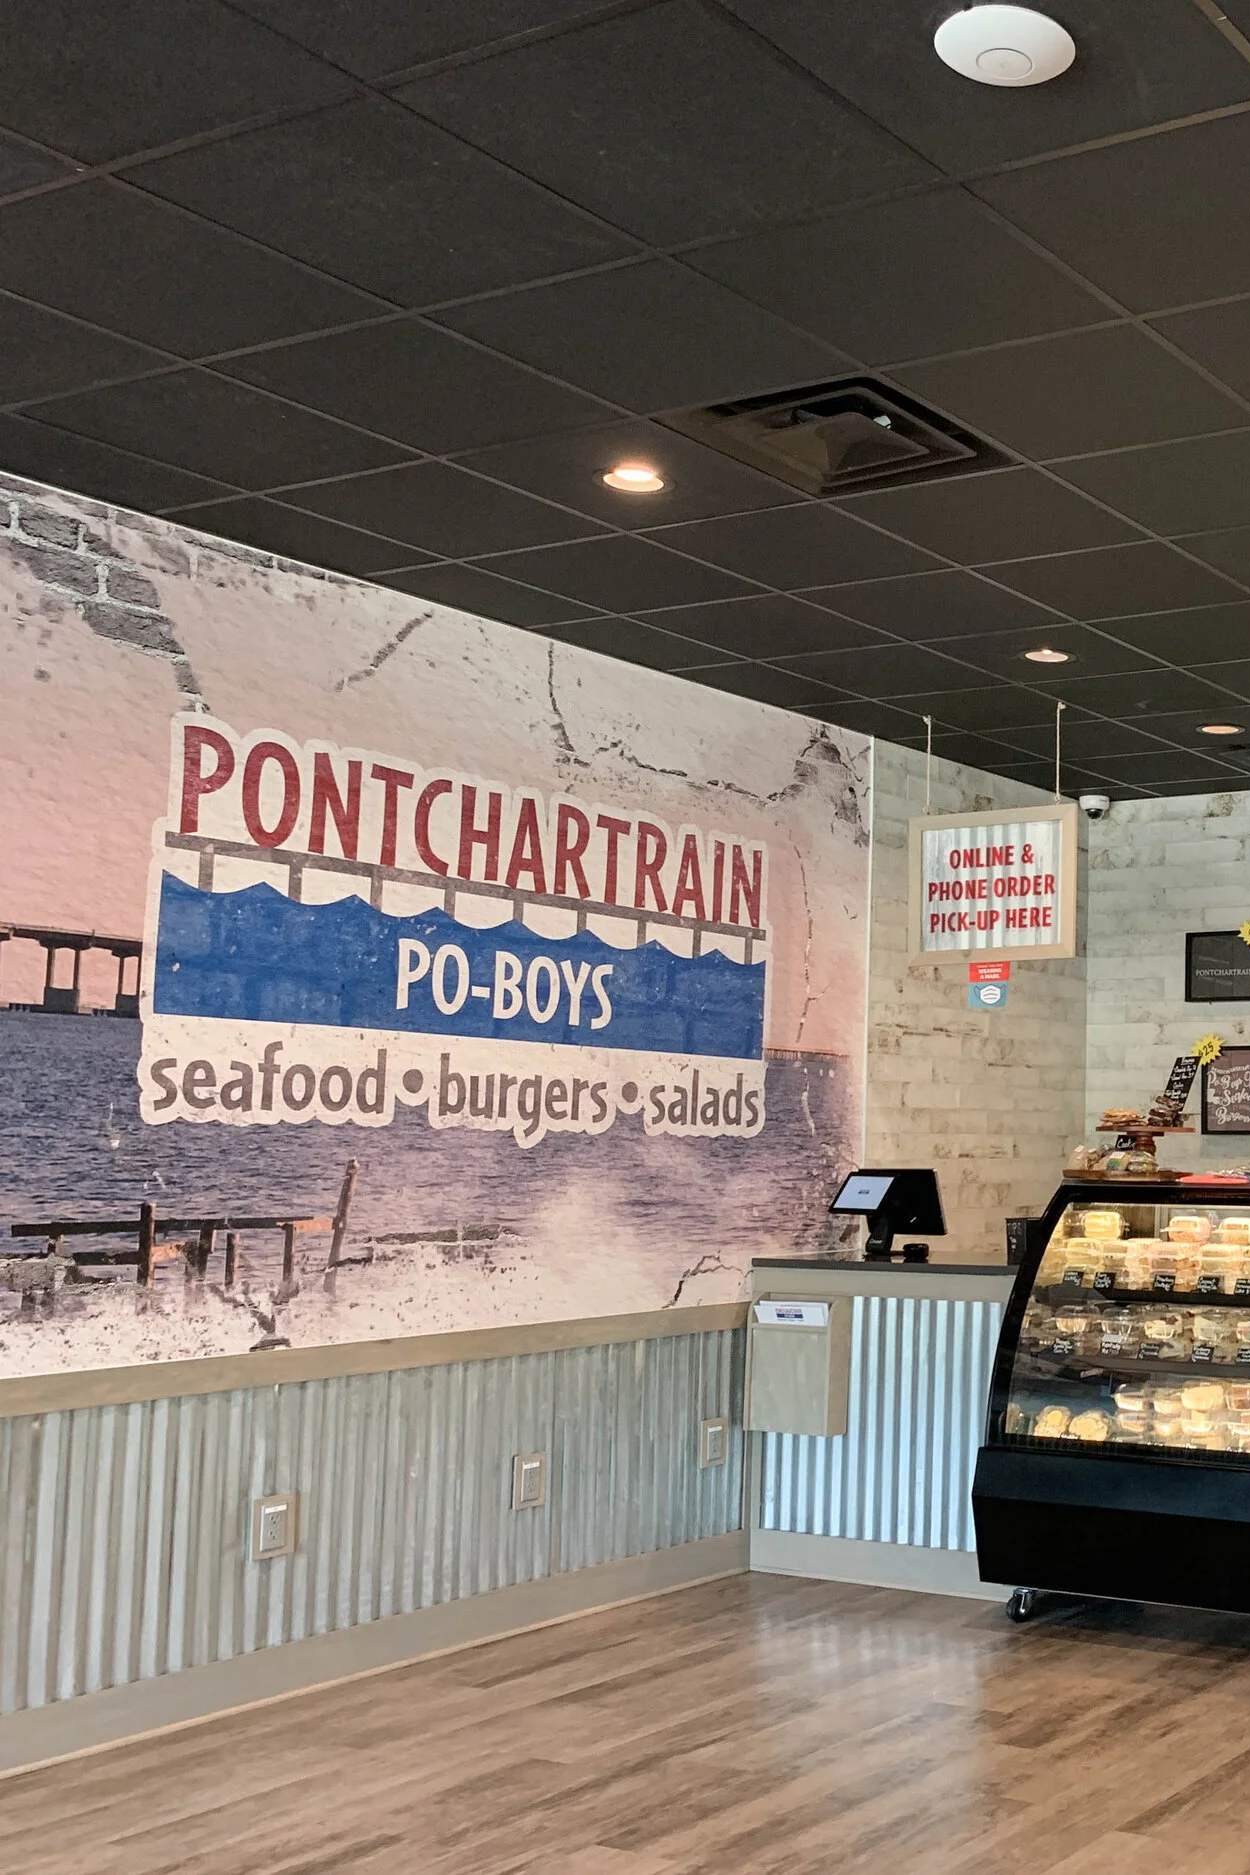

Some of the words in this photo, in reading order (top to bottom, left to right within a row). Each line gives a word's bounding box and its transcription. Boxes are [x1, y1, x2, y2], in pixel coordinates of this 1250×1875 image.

[180, 725, 762, 928] PONTCHARTRAIN
[949, 845, 1015, 870] ONLINE
[1021, 843, 1034, 865] &
[928, 878, 988, 902] PHONE
[993, 873, 1056, 899] ORDER
[930, 909, 1000, 934] PICK-UP
[1005, 906, 1053, 929] HERE
[396, 938, 614, 1029] PO-BOYS
[150, 1040, 387, 1112] seafood
[438, 1053, 608, 1136] burgers
[650, 1069, 760, 1128] salads
